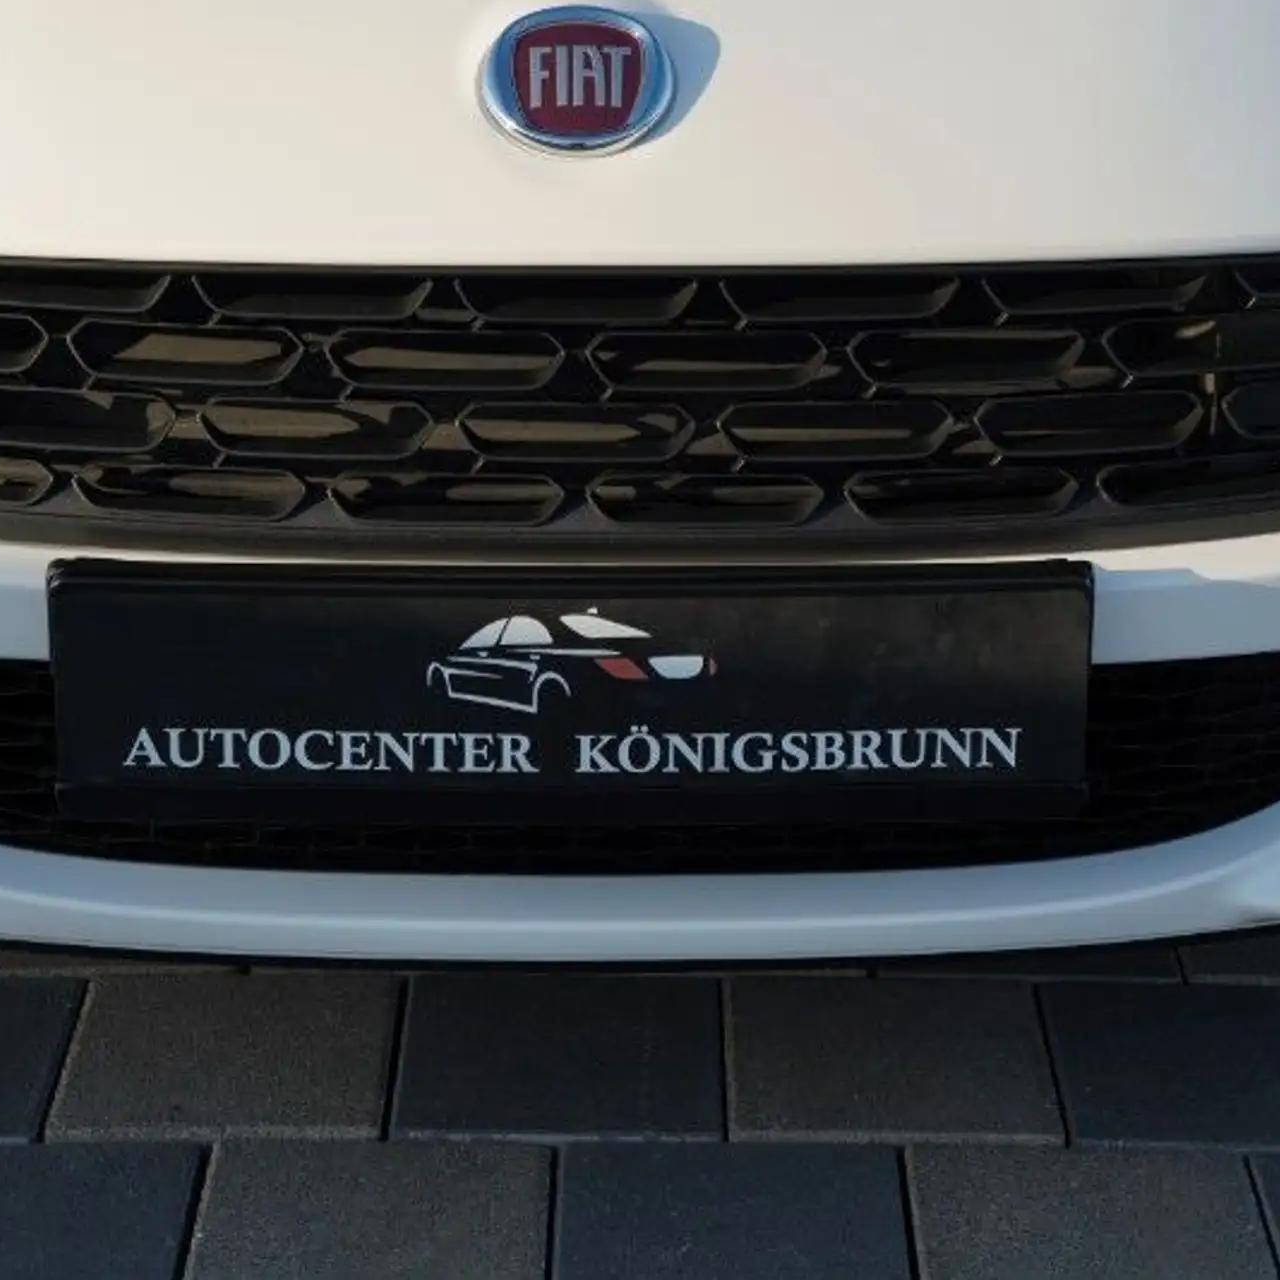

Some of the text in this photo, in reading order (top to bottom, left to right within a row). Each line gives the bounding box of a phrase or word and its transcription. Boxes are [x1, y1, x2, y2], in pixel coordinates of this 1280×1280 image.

[529, 45, 631, 110] FIAT
[123, 725, 1023, 773] AUTOCENTER KÖNIGSBRUNN
